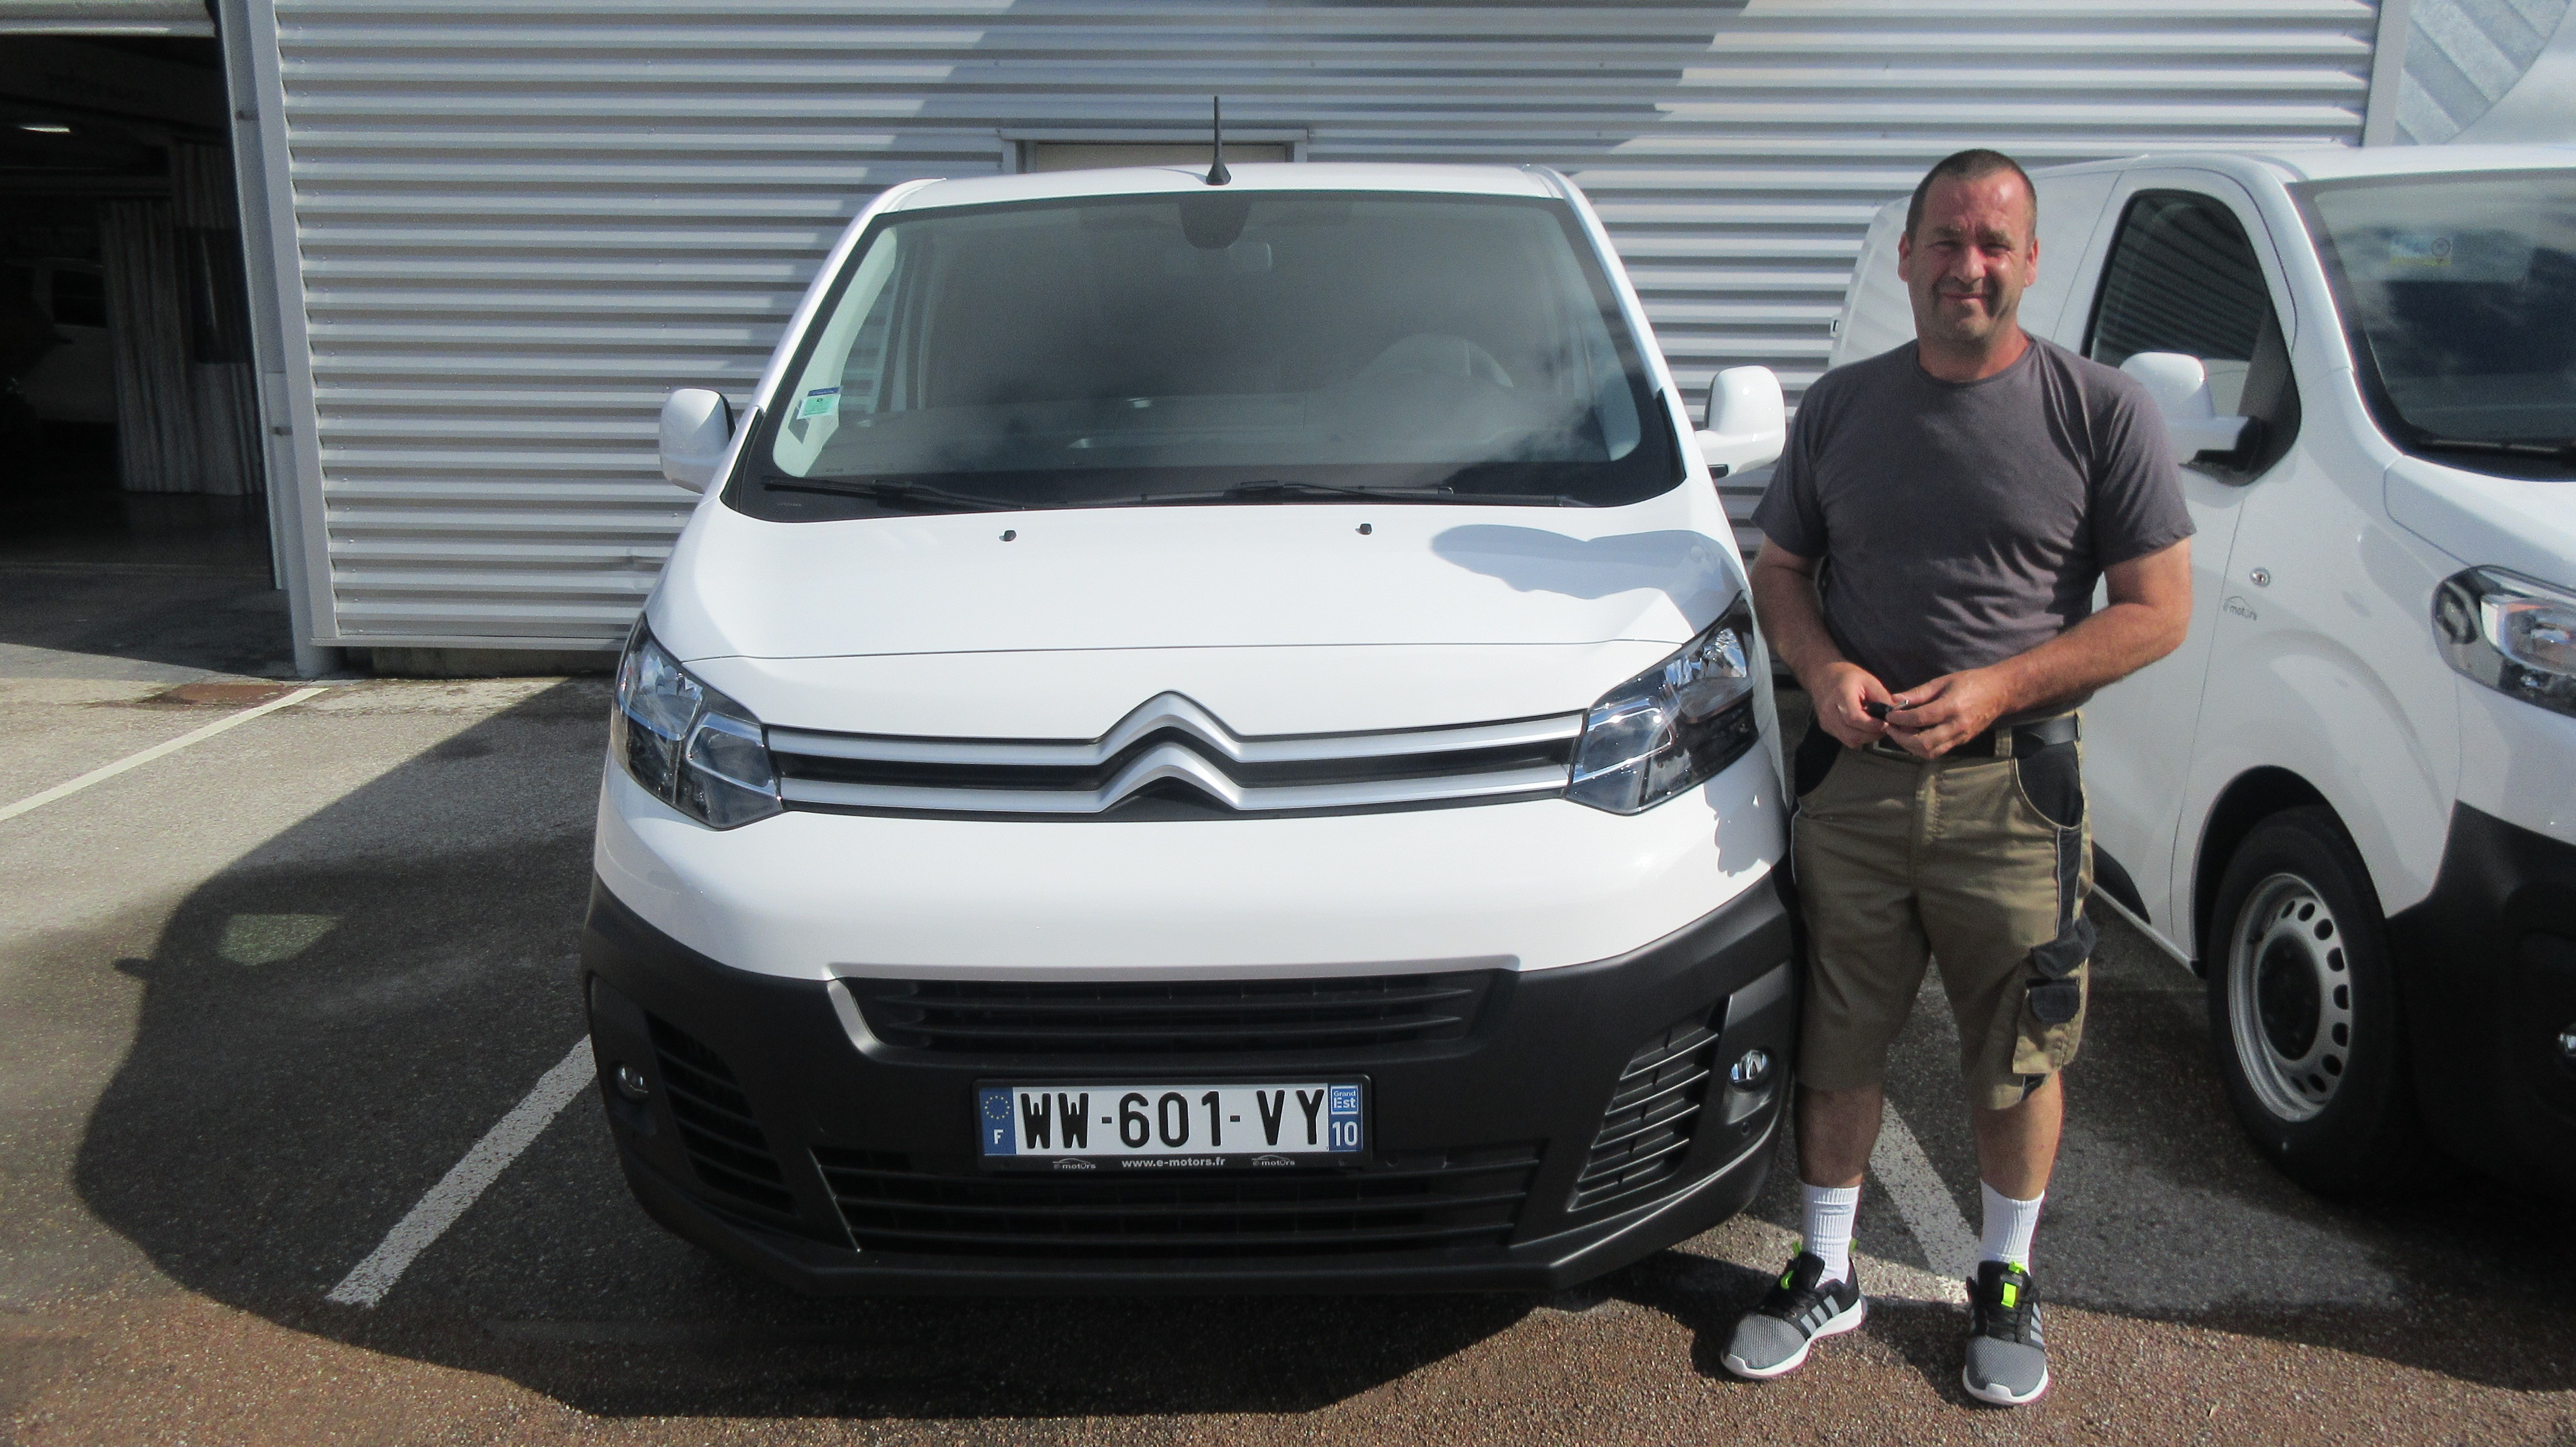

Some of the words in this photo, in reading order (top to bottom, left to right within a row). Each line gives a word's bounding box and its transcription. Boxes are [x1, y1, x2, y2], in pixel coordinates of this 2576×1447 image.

[1333, 1097, 1356, 1108] Est
[994, 1129, 1004, 1144] F
[1332, 1121, 1358, 1146] 10
[1122, 1157, 1225, 1167] www.e-motors.fr
